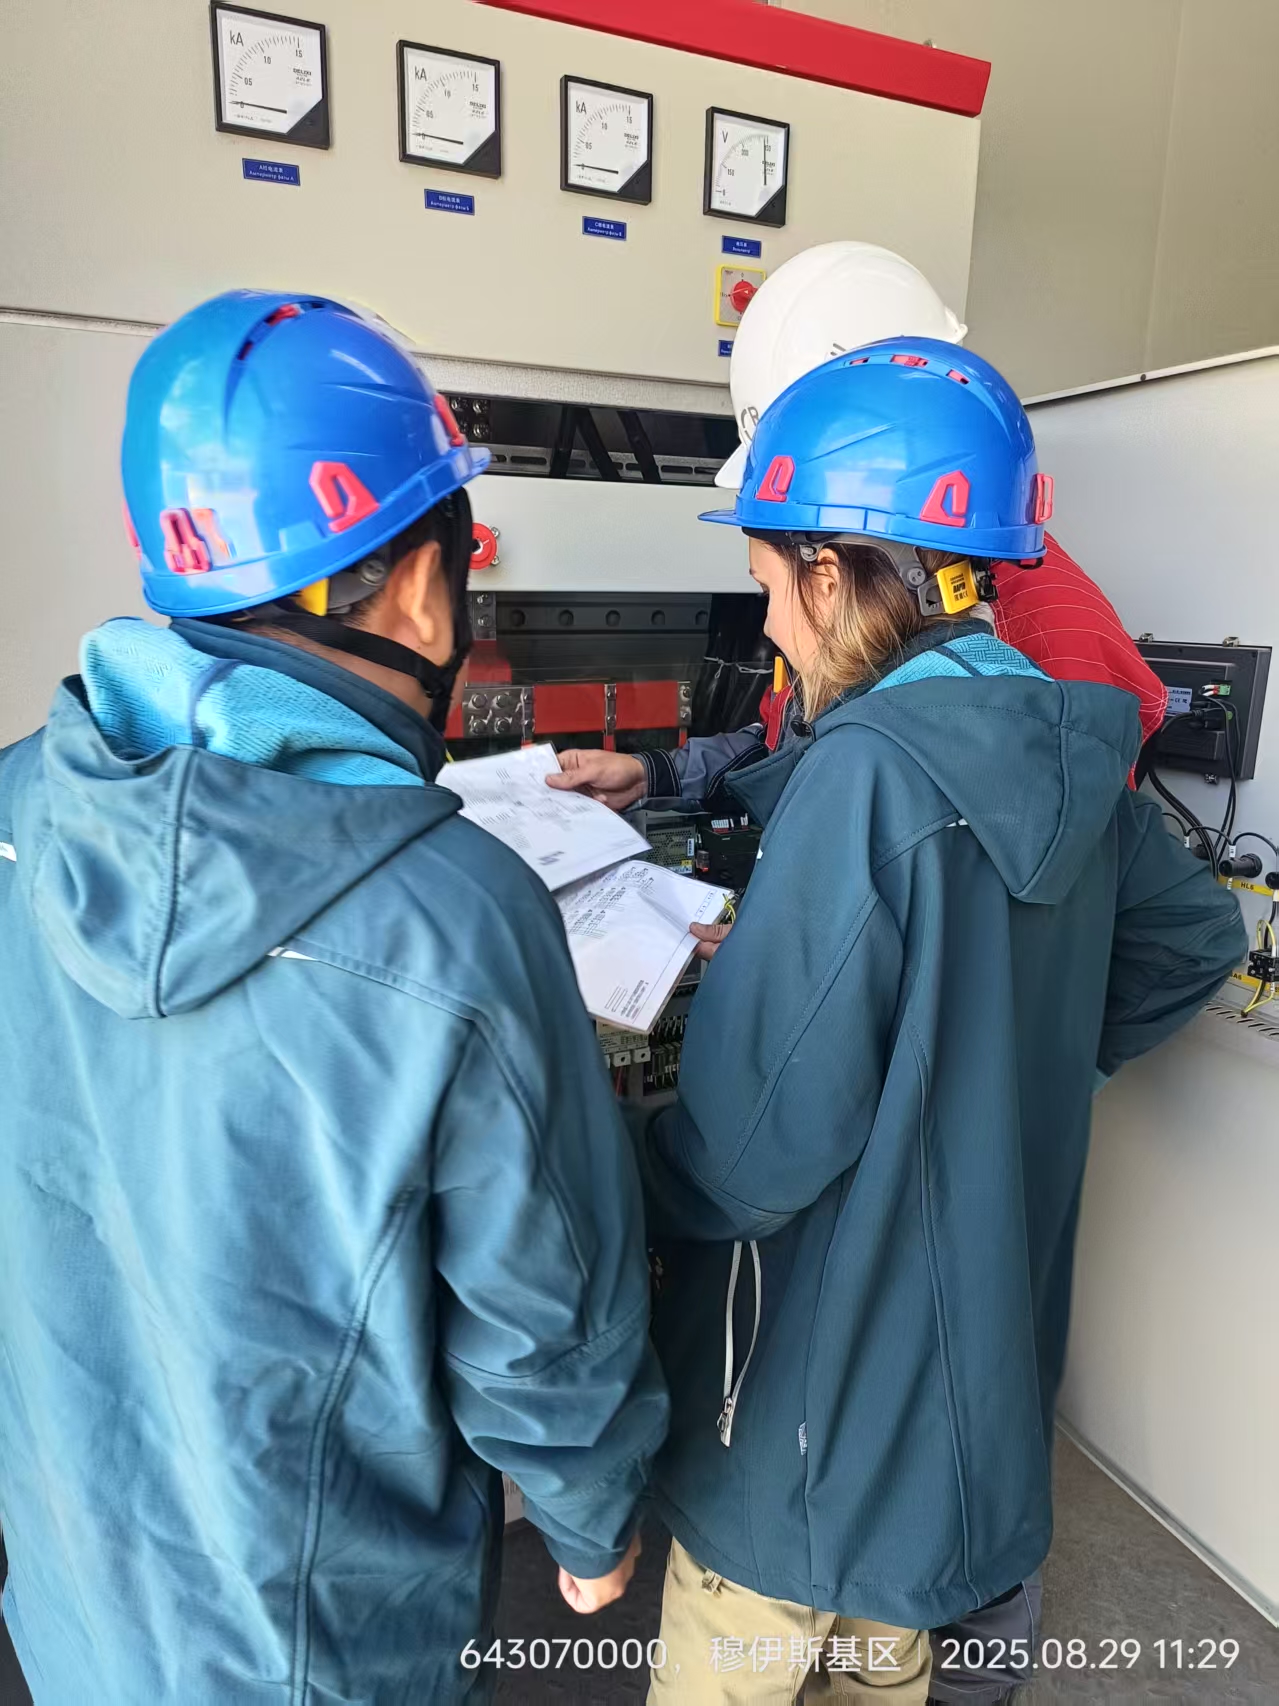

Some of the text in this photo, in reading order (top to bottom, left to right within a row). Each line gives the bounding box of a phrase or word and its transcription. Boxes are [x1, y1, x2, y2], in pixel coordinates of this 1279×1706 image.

[229, 30, 244, 47] kA
[414, 65, 427, 81] kA
[575, 100, 587, 114] kA
[721, 130, 729, 143] V
